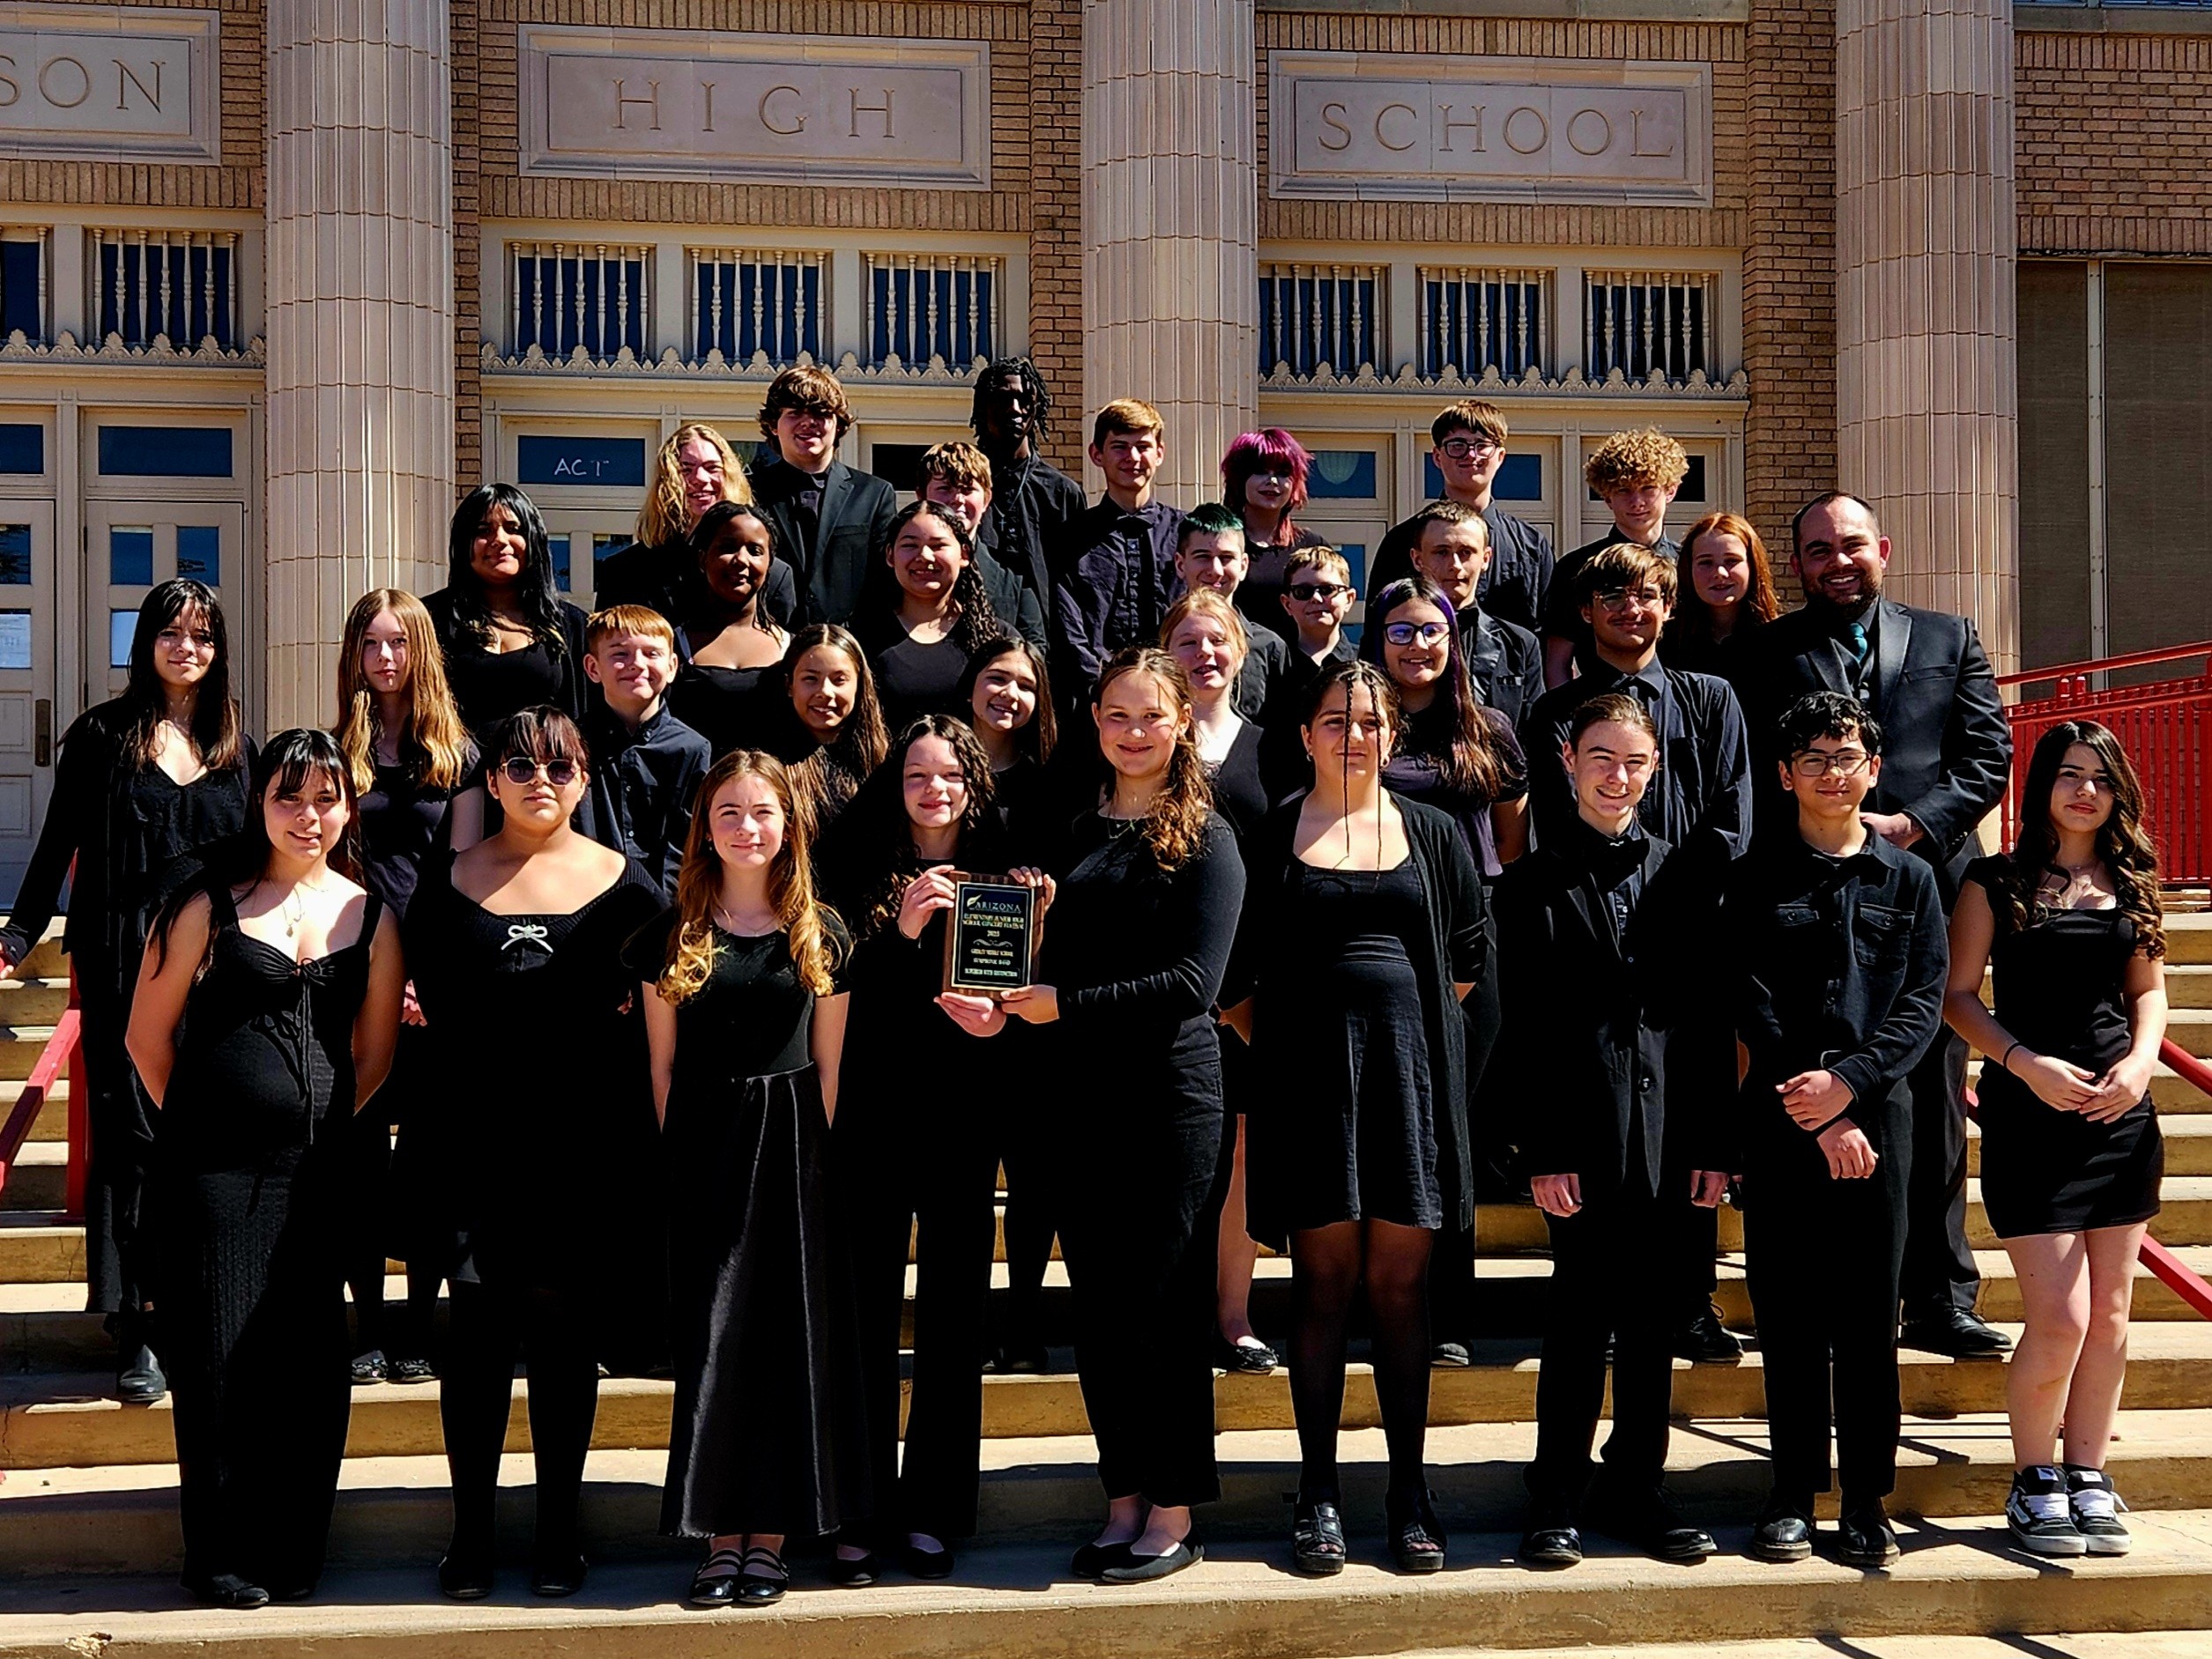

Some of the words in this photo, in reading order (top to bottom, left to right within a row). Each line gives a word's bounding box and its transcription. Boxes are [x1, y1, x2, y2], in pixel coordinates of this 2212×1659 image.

[612, 78, 894, 138] HIGH
[1318, 102, 1674, 157] SCHOOL
[553, 457, 610, 477] ACT
[975, 901, 1021, 913] ARIZONA
